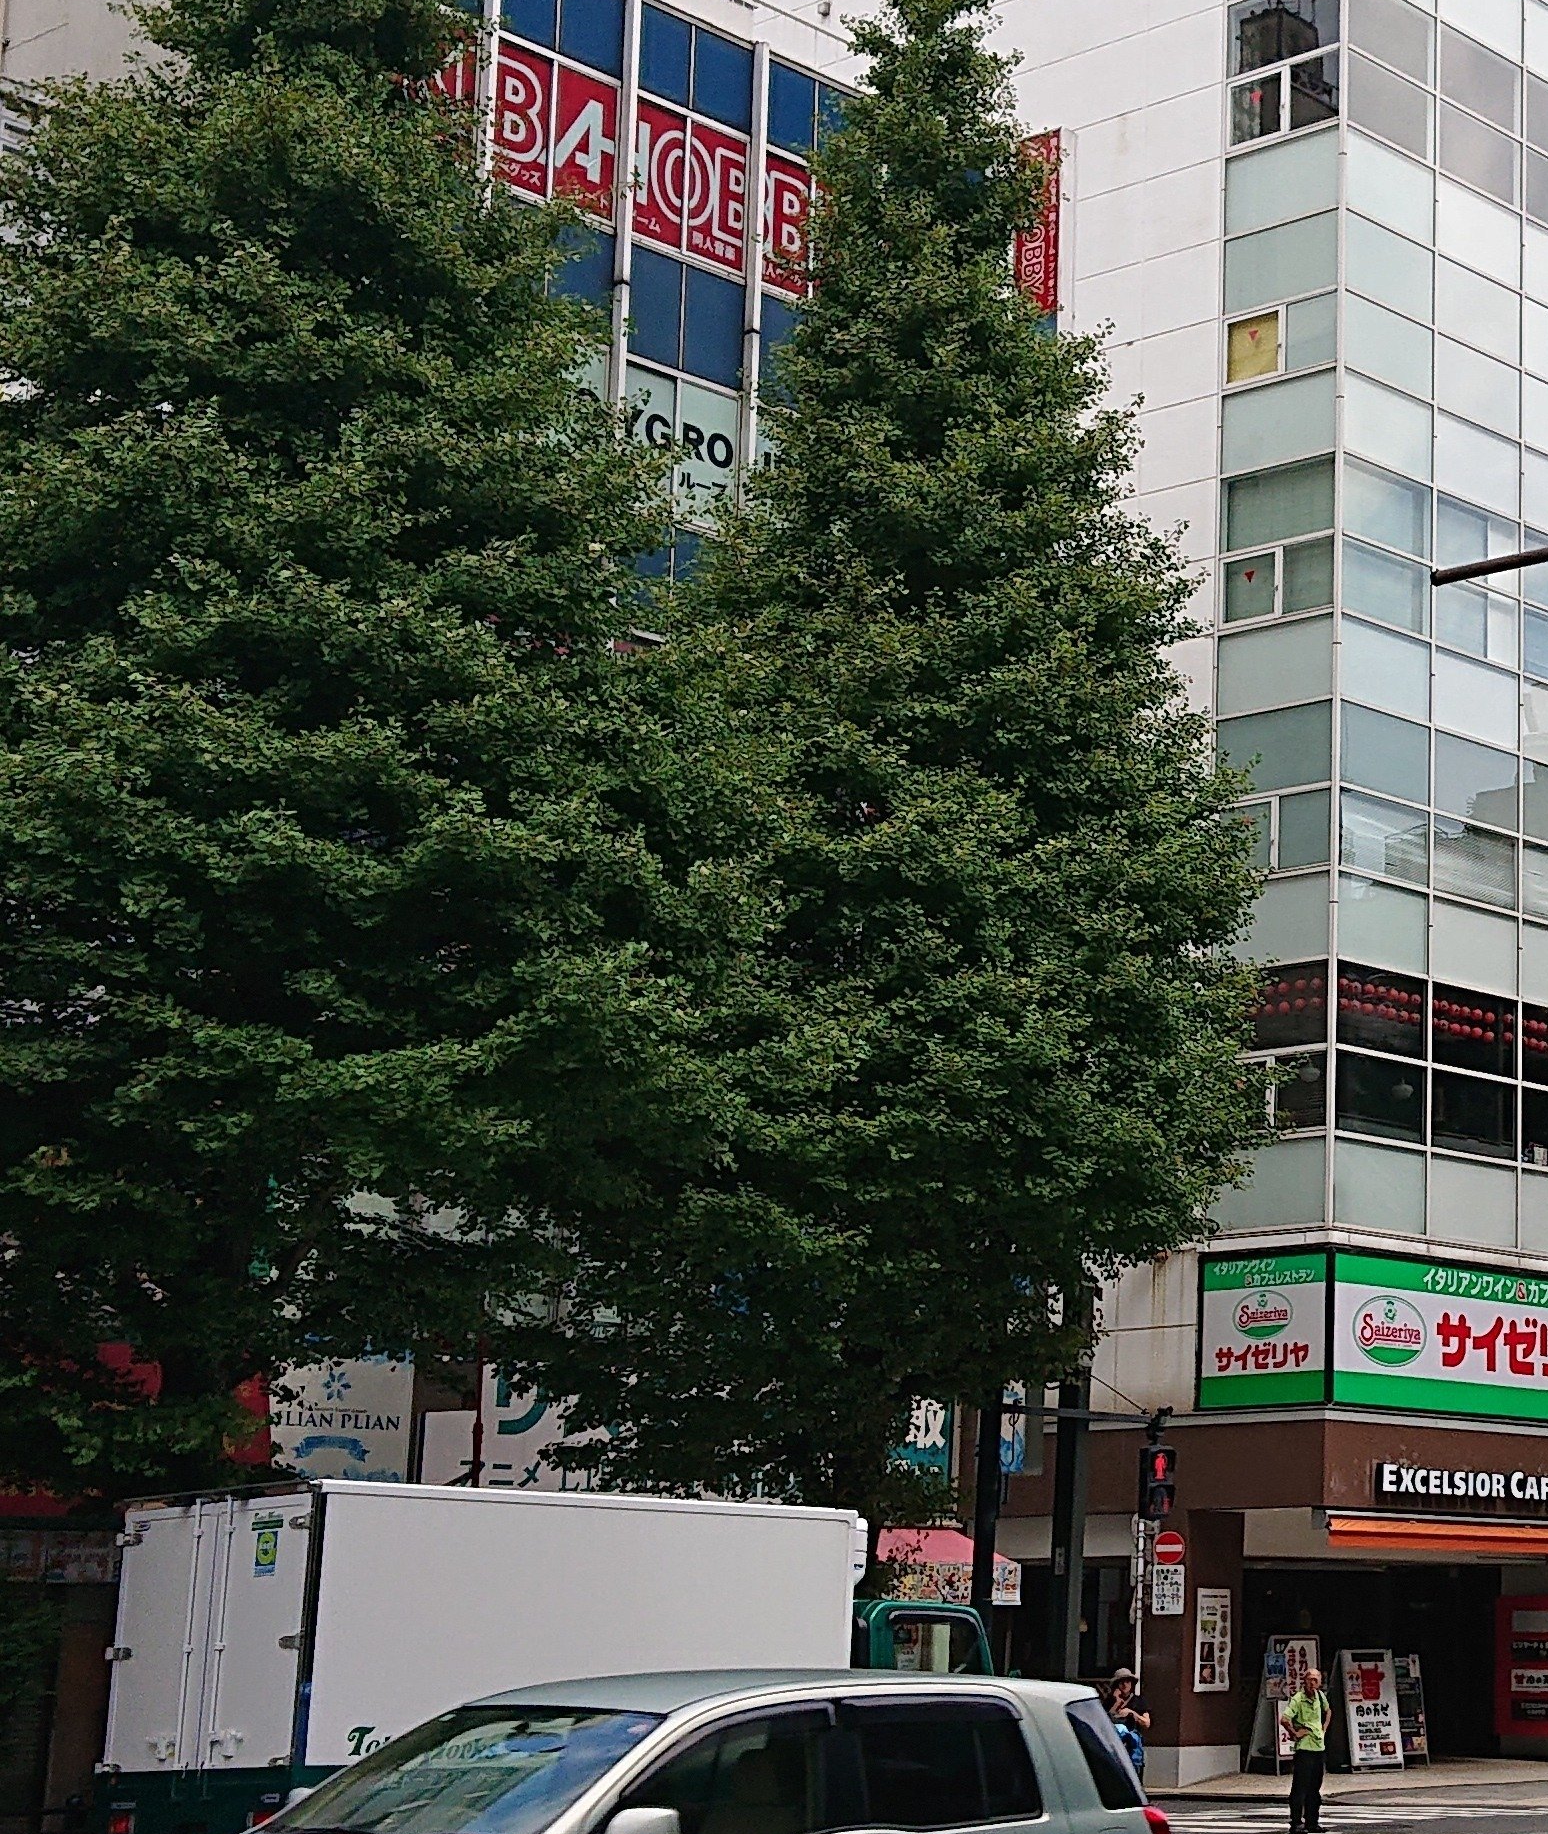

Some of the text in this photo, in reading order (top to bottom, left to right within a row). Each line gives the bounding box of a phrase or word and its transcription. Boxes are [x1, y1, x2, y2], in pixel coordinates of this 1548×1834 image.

[1213, 1258, 1276, 1276] イタリアンワイン
[1237, 1304, 1289, 1329] Saizeriya
[1358, 1312, 1421, 1347] Saizeriya
[1215, 1341, 1310, 1373] サイゼリヤ
[340, 1413, 401, 1431] PLIAN
[1382, 1462, 1506, 1499] EXCELSIOR
